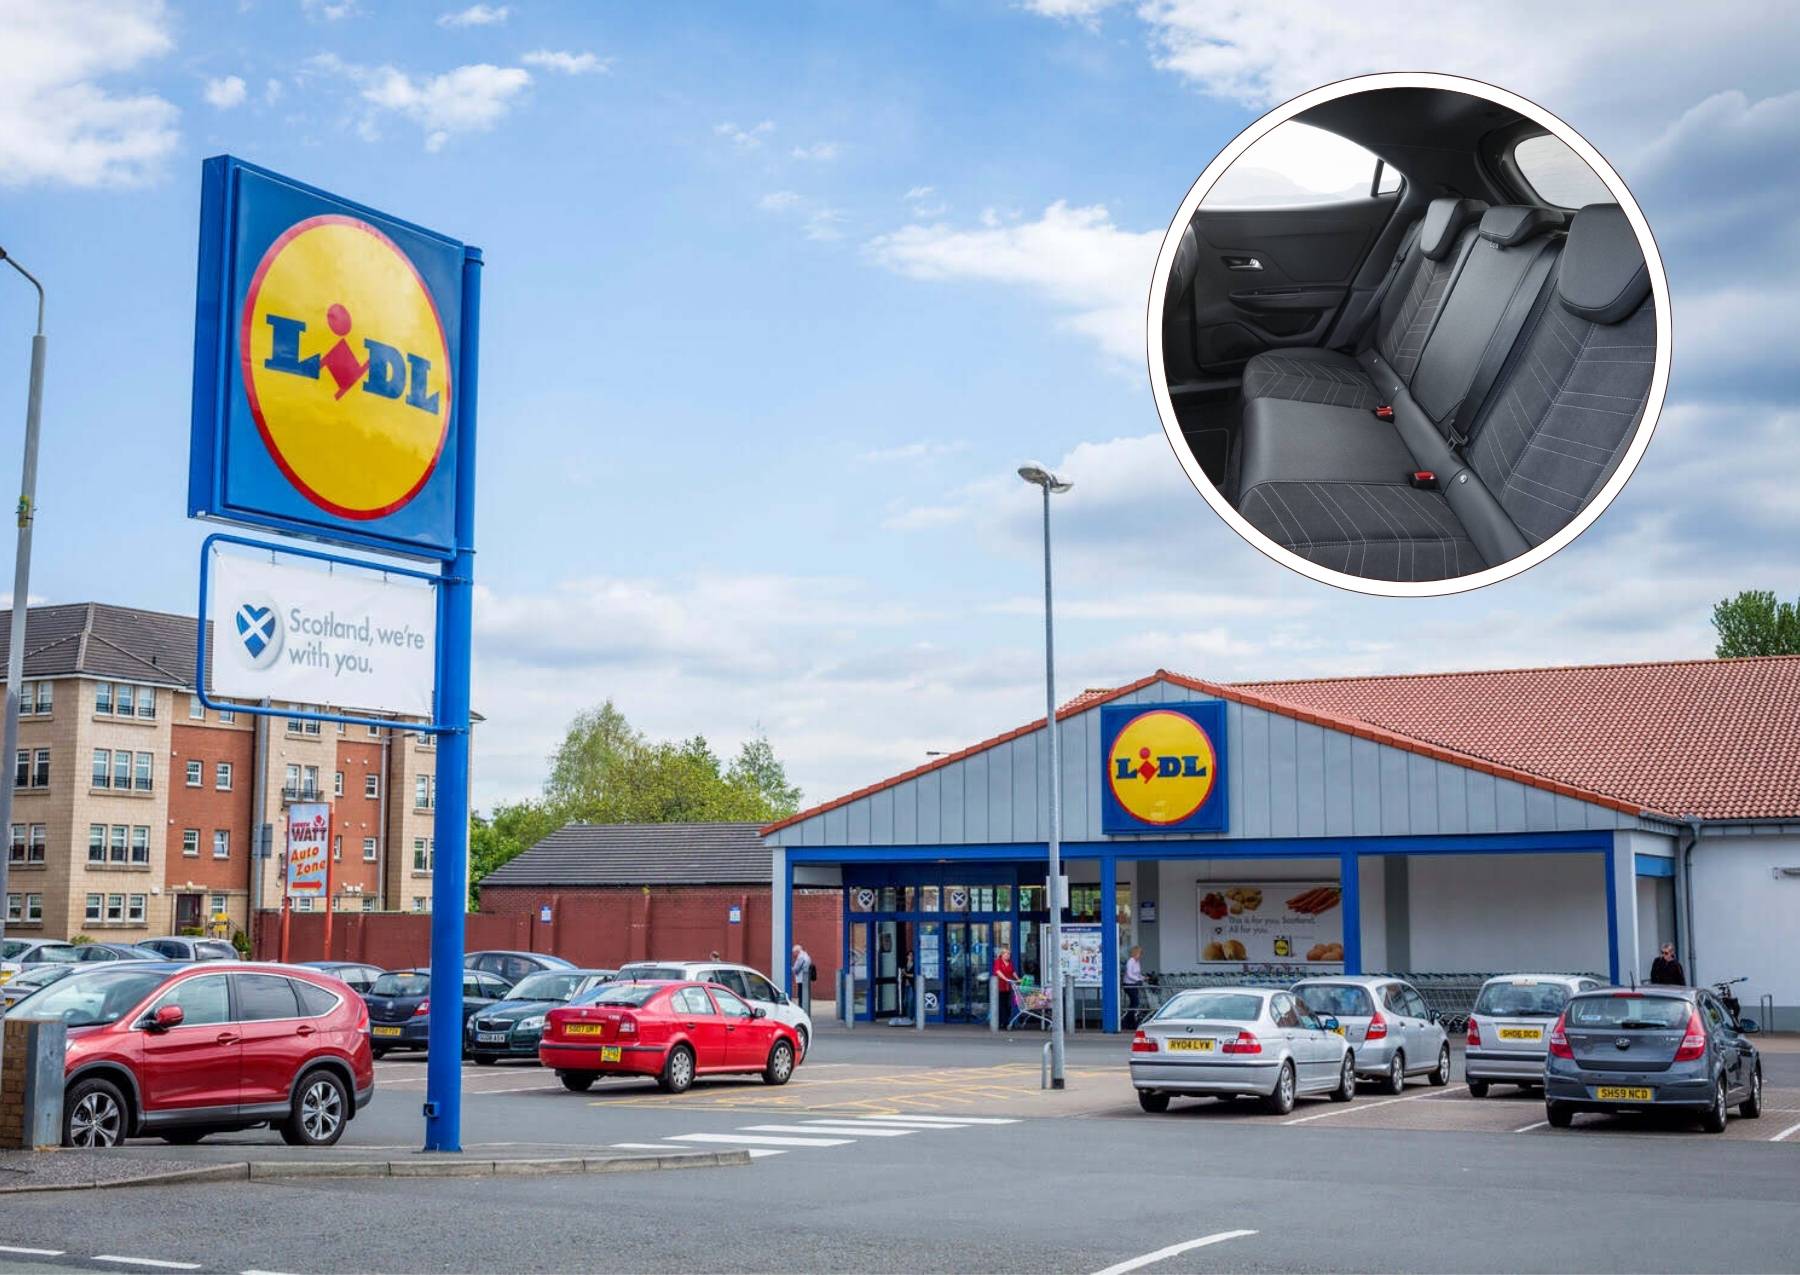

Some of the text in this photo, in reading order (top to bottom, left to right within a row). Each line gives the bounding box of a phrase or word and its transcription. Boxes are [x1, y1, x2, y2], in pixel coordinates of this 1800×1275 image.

[289, 608, 425, 649] Scotland, we're
[288, 641, 373, 677] with you.
[291, 827, 327, 841] WATT
[291, 846, 319, 863] Auto
[296, 860, 326, 877] Zone
[1601, 1088, 1648, 1099] SH59 NCD
